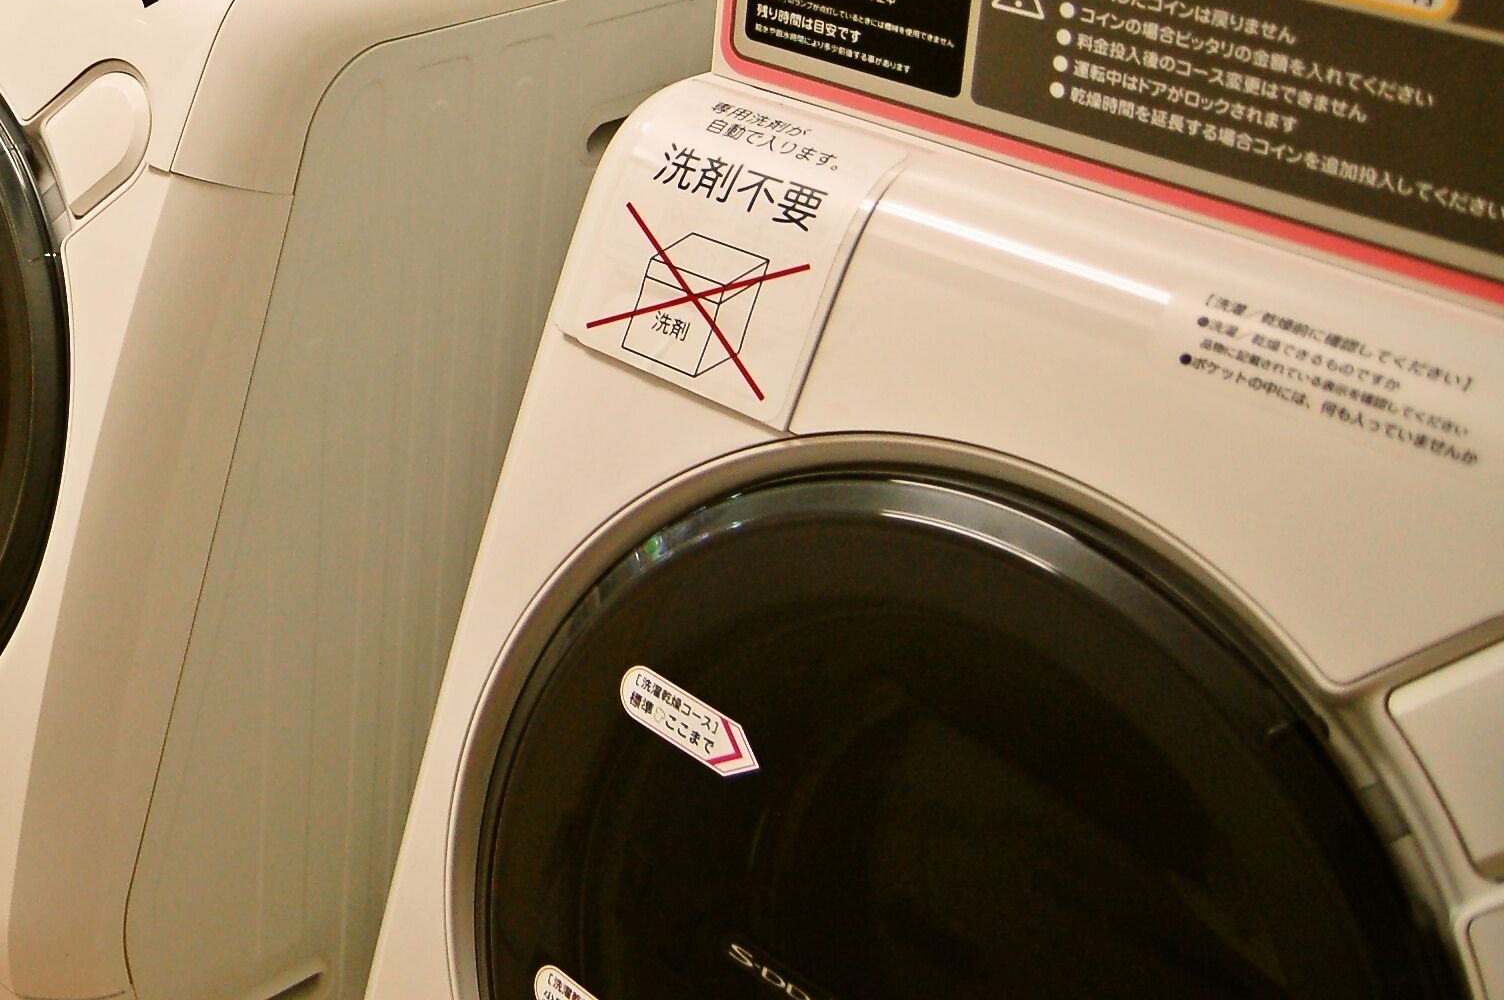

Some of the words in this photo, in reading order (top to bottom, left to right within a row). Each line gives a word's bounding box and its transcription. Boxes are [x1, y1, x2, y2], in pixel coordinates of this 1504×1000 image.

[756, 3, 862, 44] 残り時間は目安です
[1077, 33, 1369, 124] 料金投入後のコース変更はできません
[1080, 6, 1434, 107] コインの場合ピッタリの金額を入れてください
[711, 101, 811, 137] 専用洗剤が
[1073, 59, 1297, 133] 運転中はドアがロックされます
[706, 119, 839, 171] 自動で入ります。
[653, 143, 829, 232] 洗剤不要
[651, 310, 691, 342] 洗剤
[664, 715, 715, 755] ここまで
